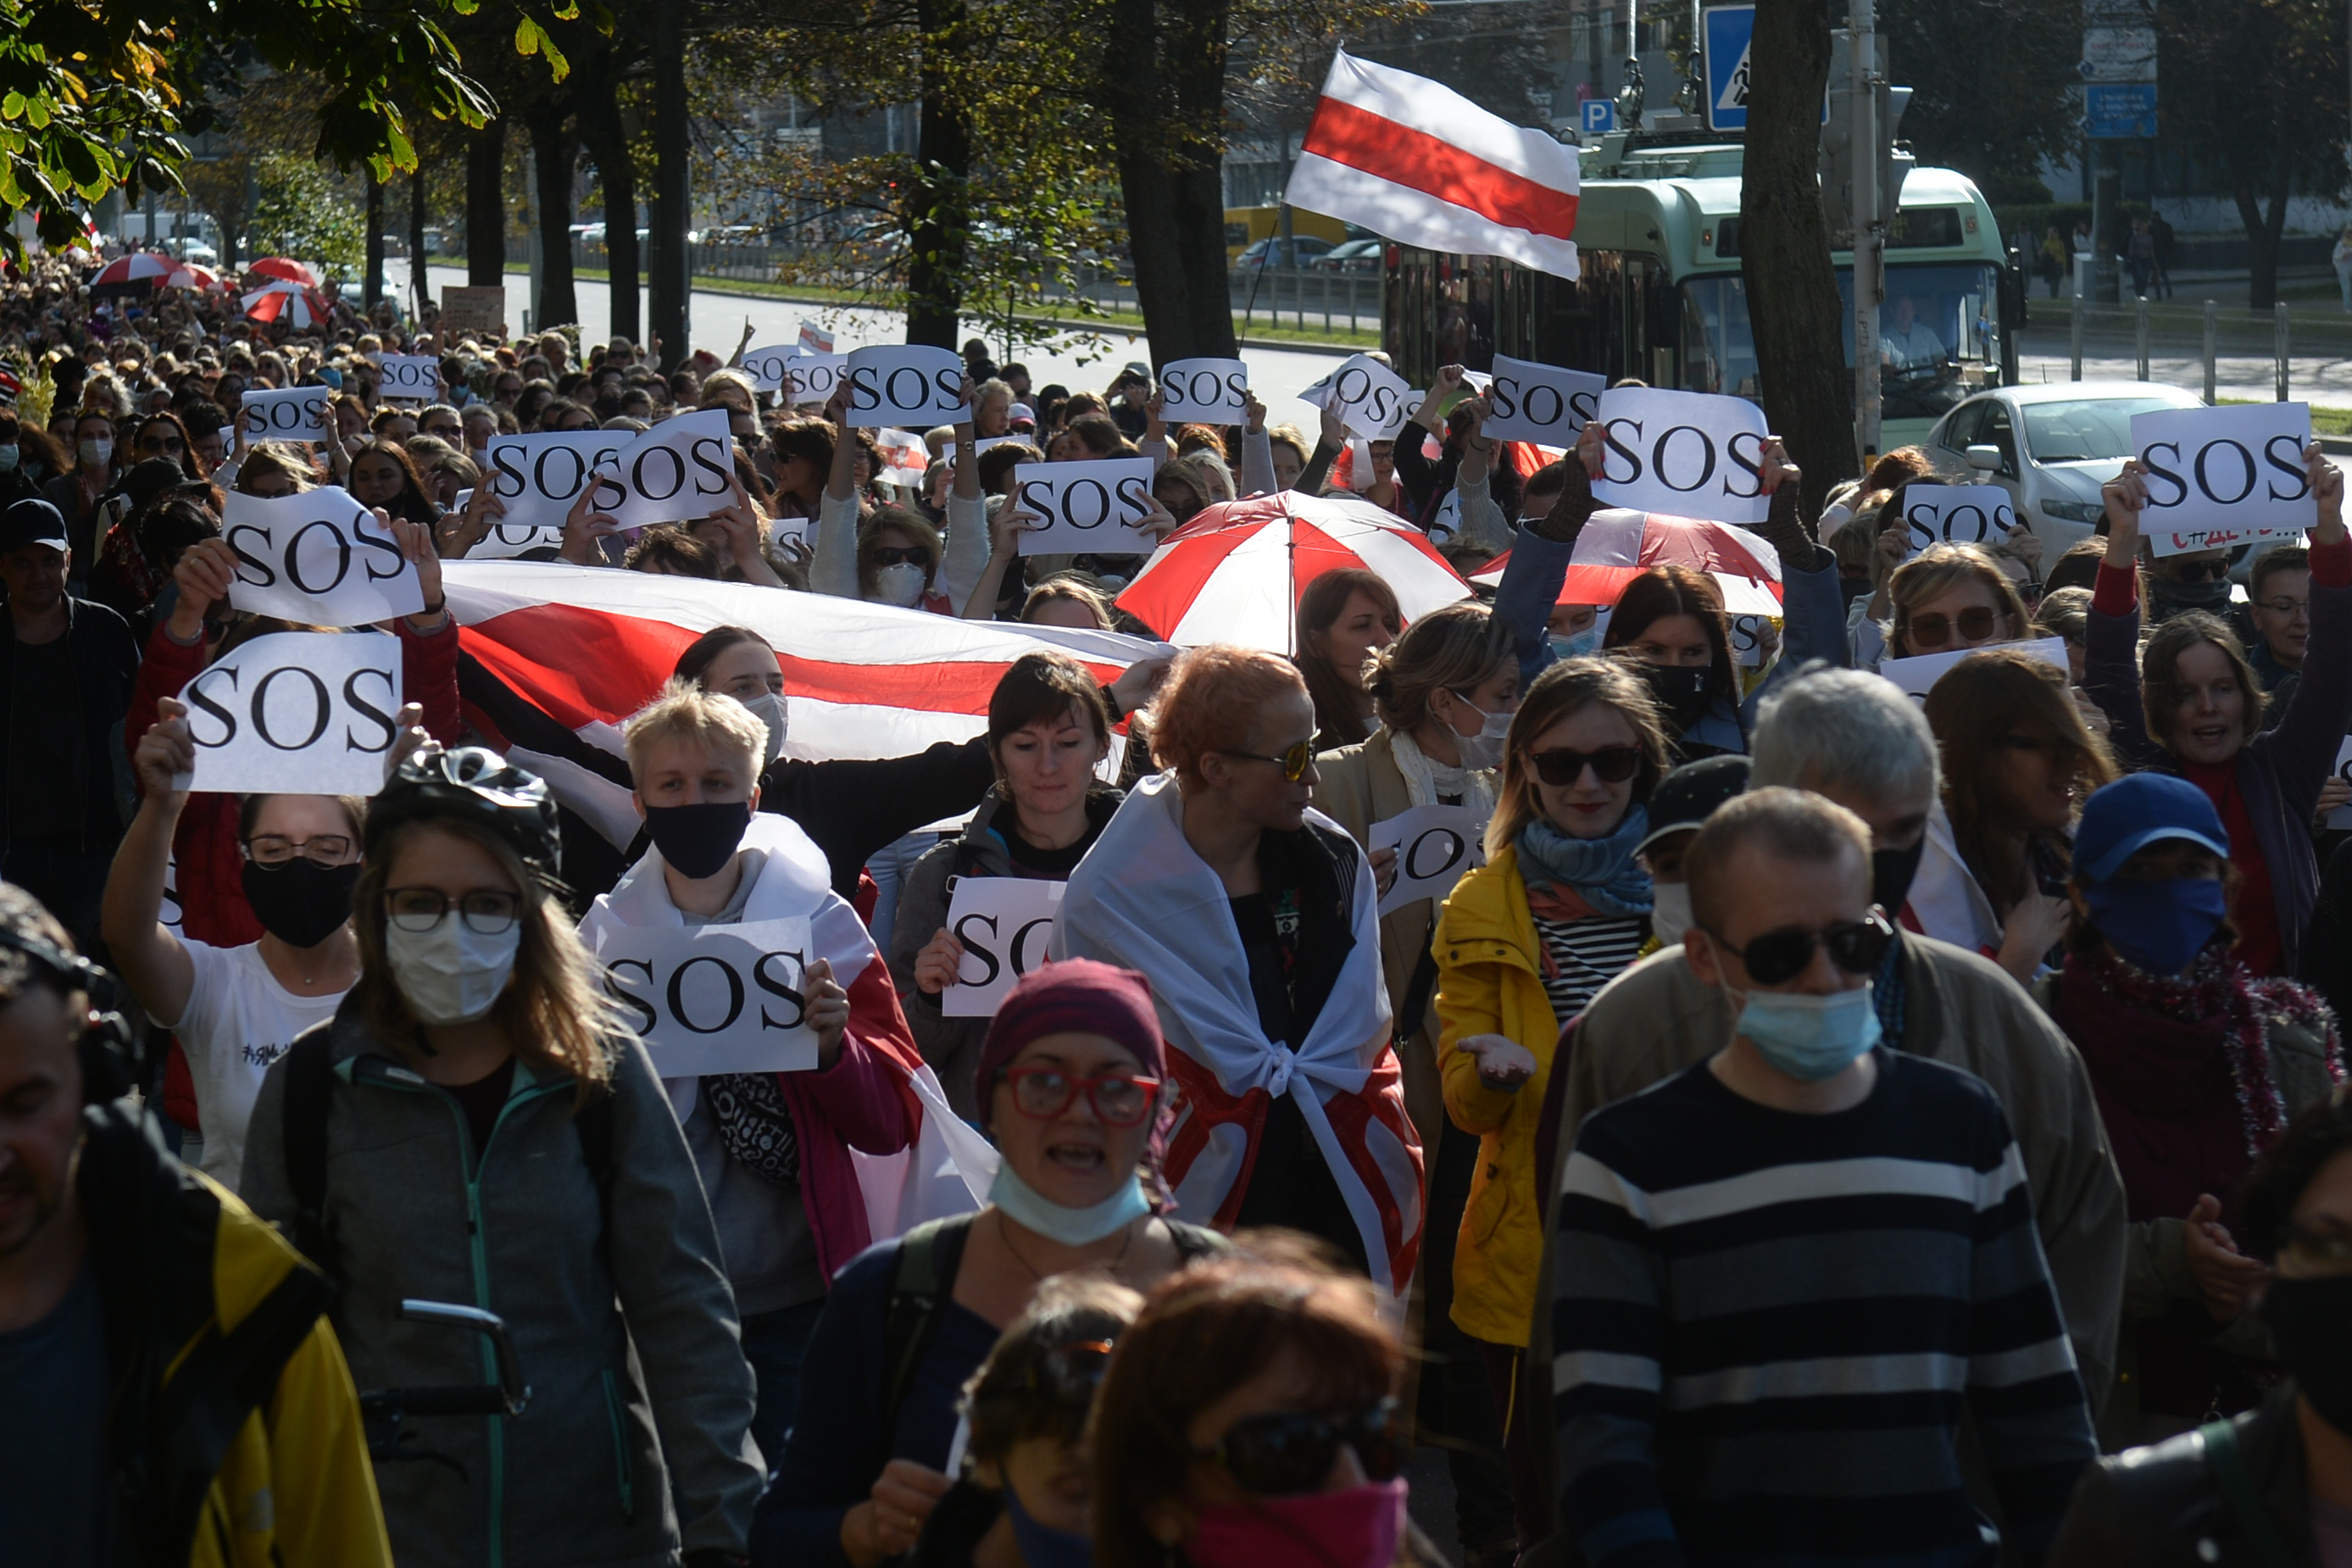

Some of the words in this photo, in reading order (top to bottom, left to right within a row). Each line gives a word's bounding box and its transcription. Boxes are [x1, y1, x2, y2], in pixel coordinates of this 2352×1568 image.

[1588, 103, 1607, 129] P
[382, 362, 437, 387] SOS
[744, 356, 800, 383] SO
[850, 366, 964, 410] SOS
[1163, 370, 1247, 409] SOS
[247, 398, 324, 434] SOS
[1493, 376, 1599, 433] SOS
[587, 437, 731, 513] SOS
[1604, 418, 1765, 498] SOS
[2142, 435, 2309, 508] SOS
[1020, 477, 1149, 531] SOS
[226, 509, 406, 594] SOS
[187, 665, 397, 753] SOS
[603, 948, 806, 1037] SOS
